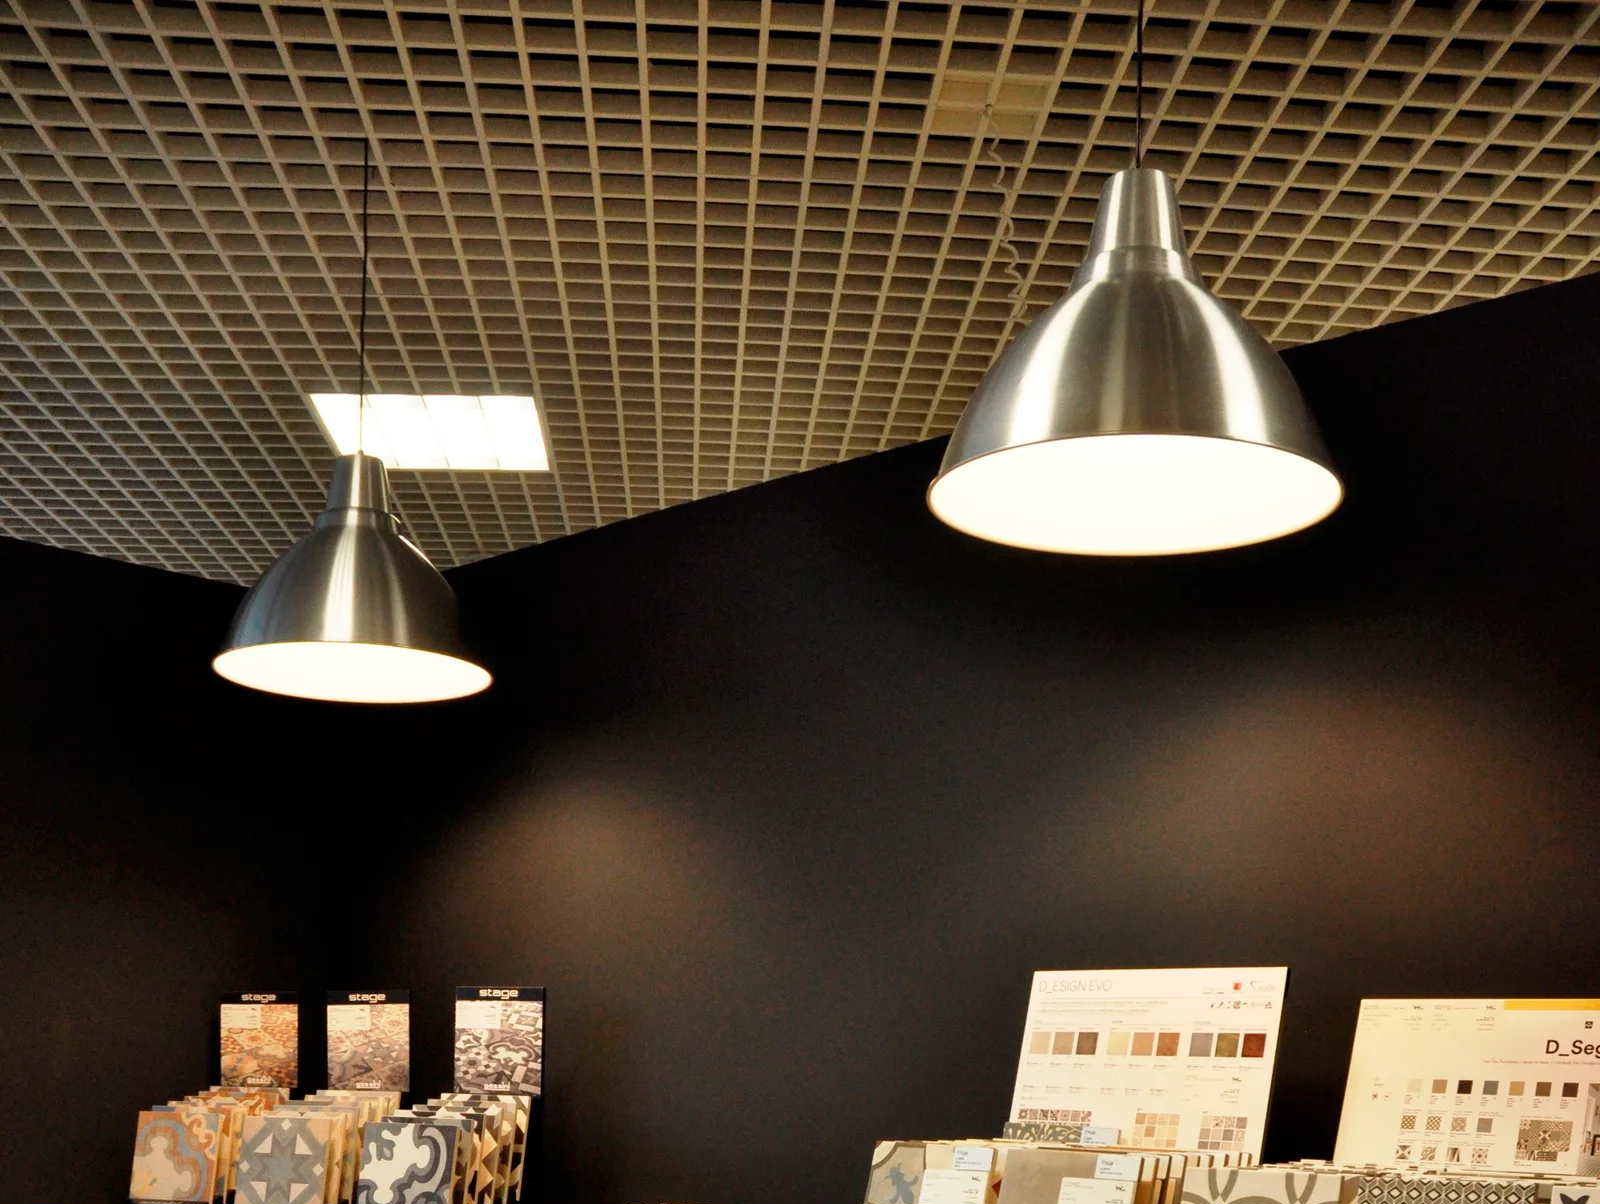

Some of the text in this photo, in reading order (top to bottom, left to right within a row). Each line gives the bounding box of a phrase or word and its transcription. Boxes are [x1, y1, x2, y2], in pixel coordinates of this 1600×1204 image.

[1088, 979, 1112, 992] EVO
[241, 993, 277, 1003] stage
[348, 992, 386, 1003] stage
[479, 988, 519, 1000] stage
